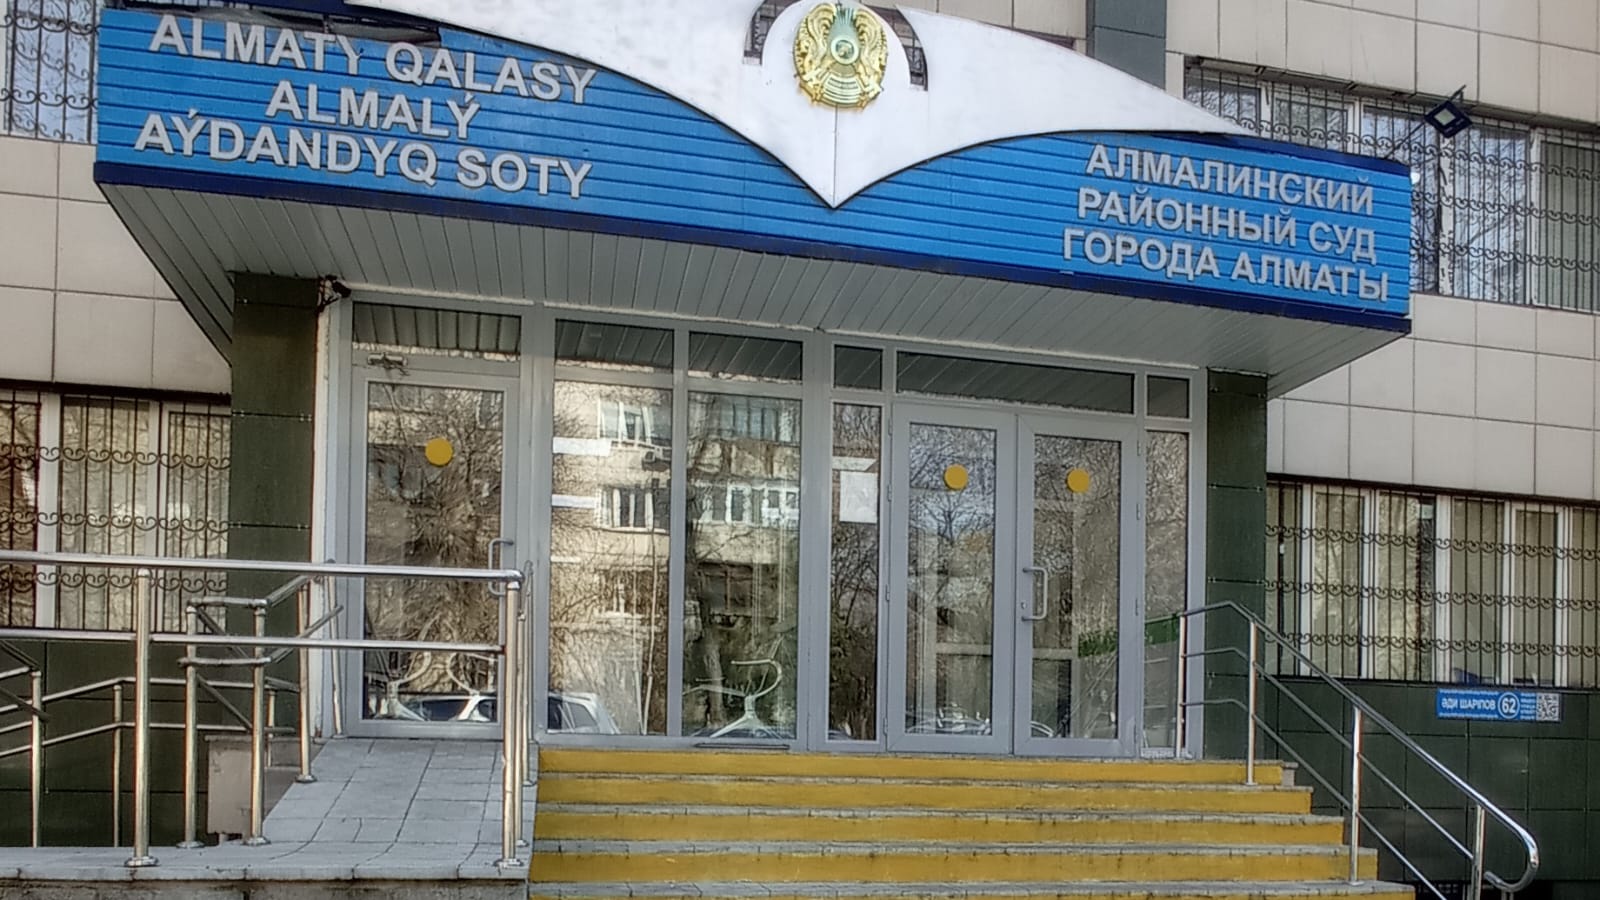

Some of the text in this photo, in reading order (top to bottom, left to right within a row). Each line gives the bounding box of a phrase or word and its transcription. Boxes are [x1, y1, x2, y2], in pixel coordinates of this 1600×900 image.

[149, 14, 598, 104] ALMATY QALASY
[265, 80, 481, 140] ALMALÝ
[134, 109, 594, 199] AÝDANDYQ SOTY
[1086, 143, 1374, 216] АЛМАЛИНСКИЙ
[1077, 185, 1377, 265] РАЙОННЫЙ СУД
[1063, 228, 1389, 301] ГОРОДА АЛМАТЫ
[1501, 698, 1516, 713] 62
